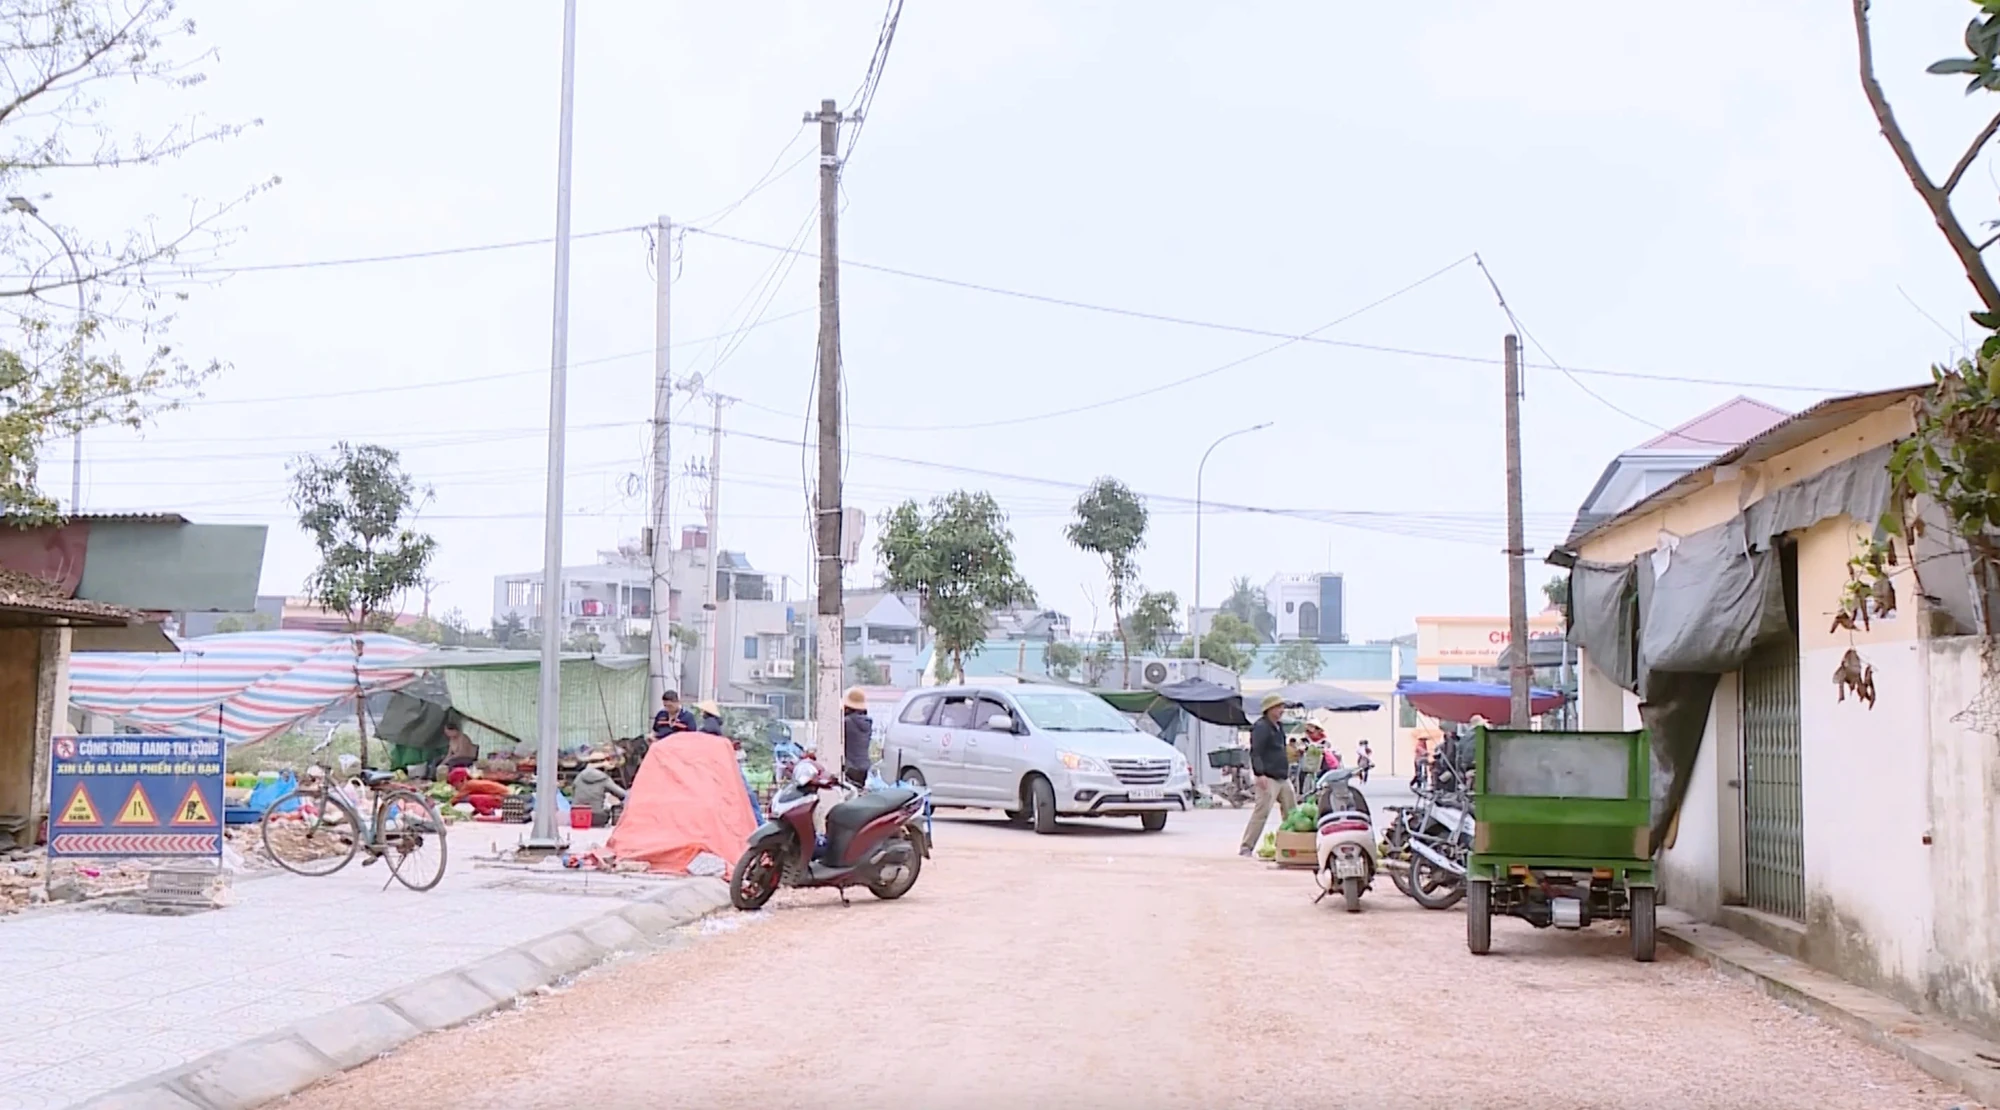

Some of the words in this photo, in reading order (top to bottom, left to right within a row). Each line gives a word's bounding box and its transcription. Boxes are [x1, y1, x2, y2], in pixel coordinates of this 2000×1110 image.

[79, 739, 108, 756] CÔNG
[172, 741, 189, 756] THI
[57, 763, 76, 774] XIN
[114, 760, 138, 774] LÀM
[198, 762, 220, 776] BẠN
